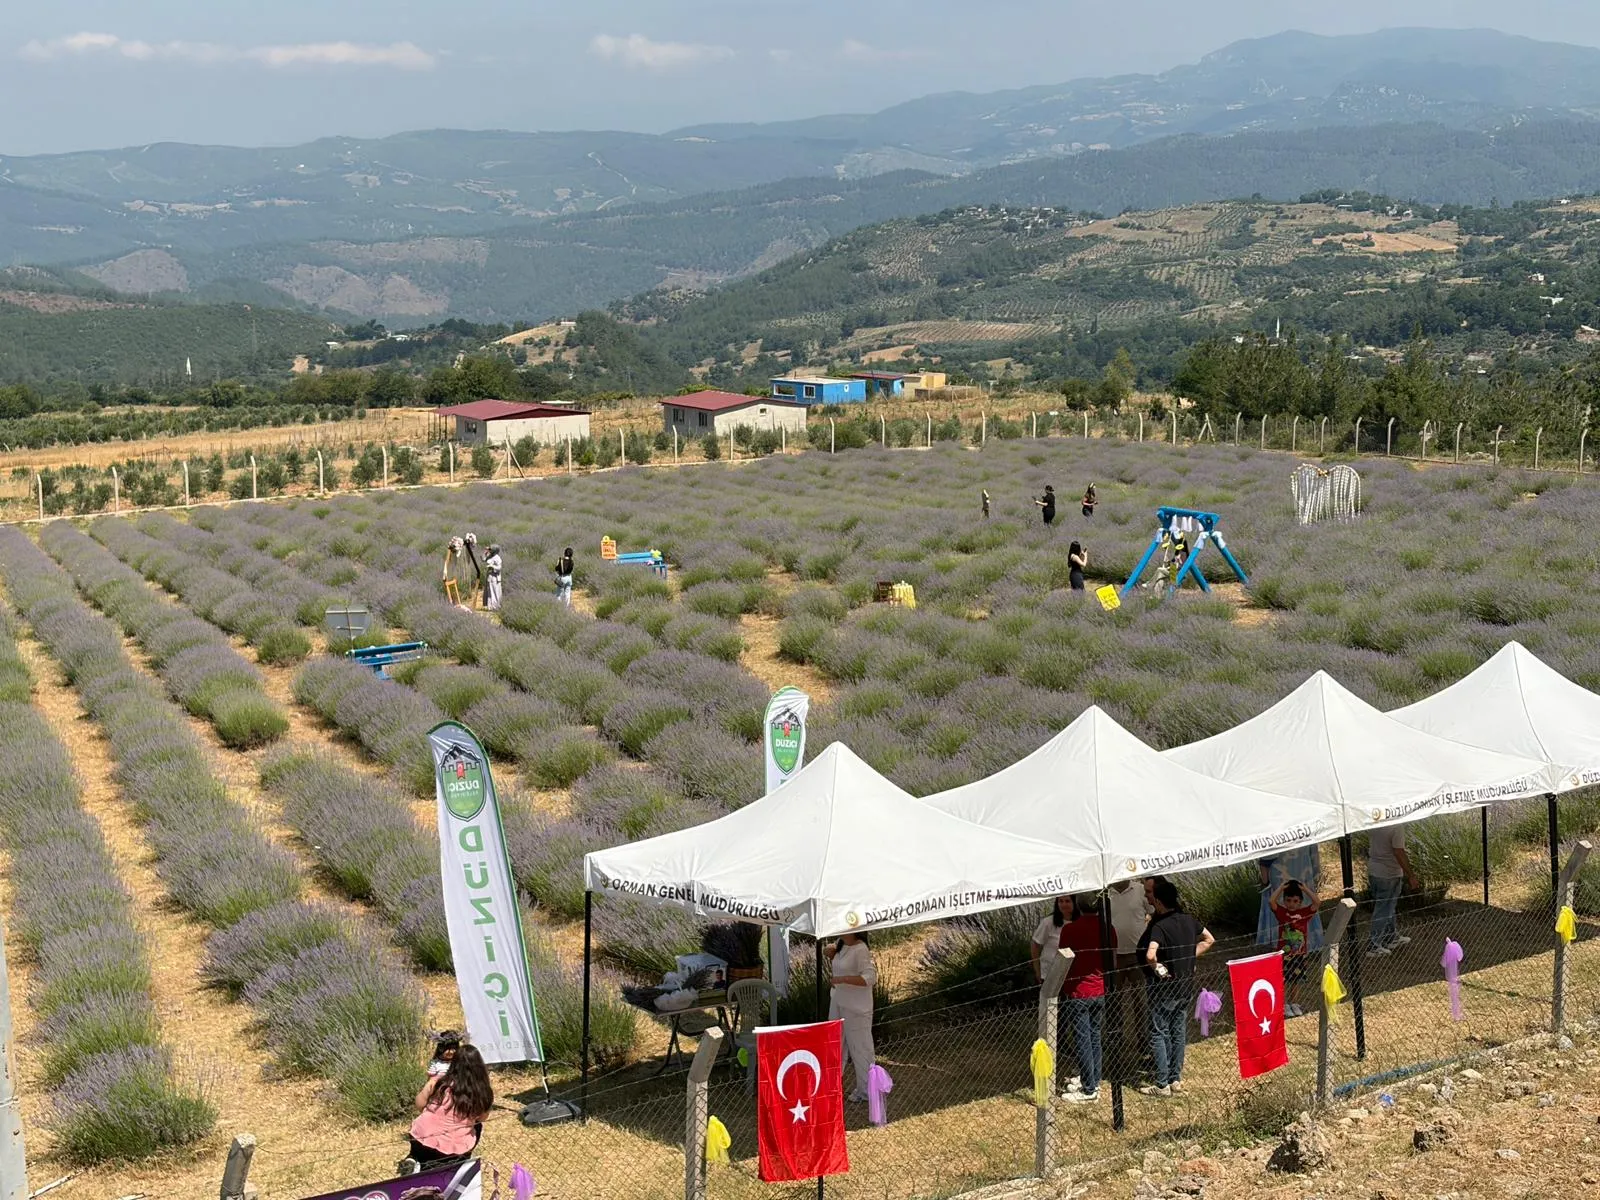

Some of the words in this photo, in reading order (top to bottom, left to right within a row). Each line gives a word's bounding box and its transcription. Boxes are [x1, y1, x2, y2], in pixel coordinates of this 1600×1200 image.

[1212, 840, 1249, 860] İŞLETME
[612, 878, 657, 897] ORMAN
[659, 885, 697, 904] GENEL
[700, 889, 780, 921] MÜDÜRLÜĞÜ
[906, 895, 946, 917] ORMAN
[949, 889, 992, 909] İŞLETME
[995, 874, 1064, 899] MÜDÜRLÜĞÜ
